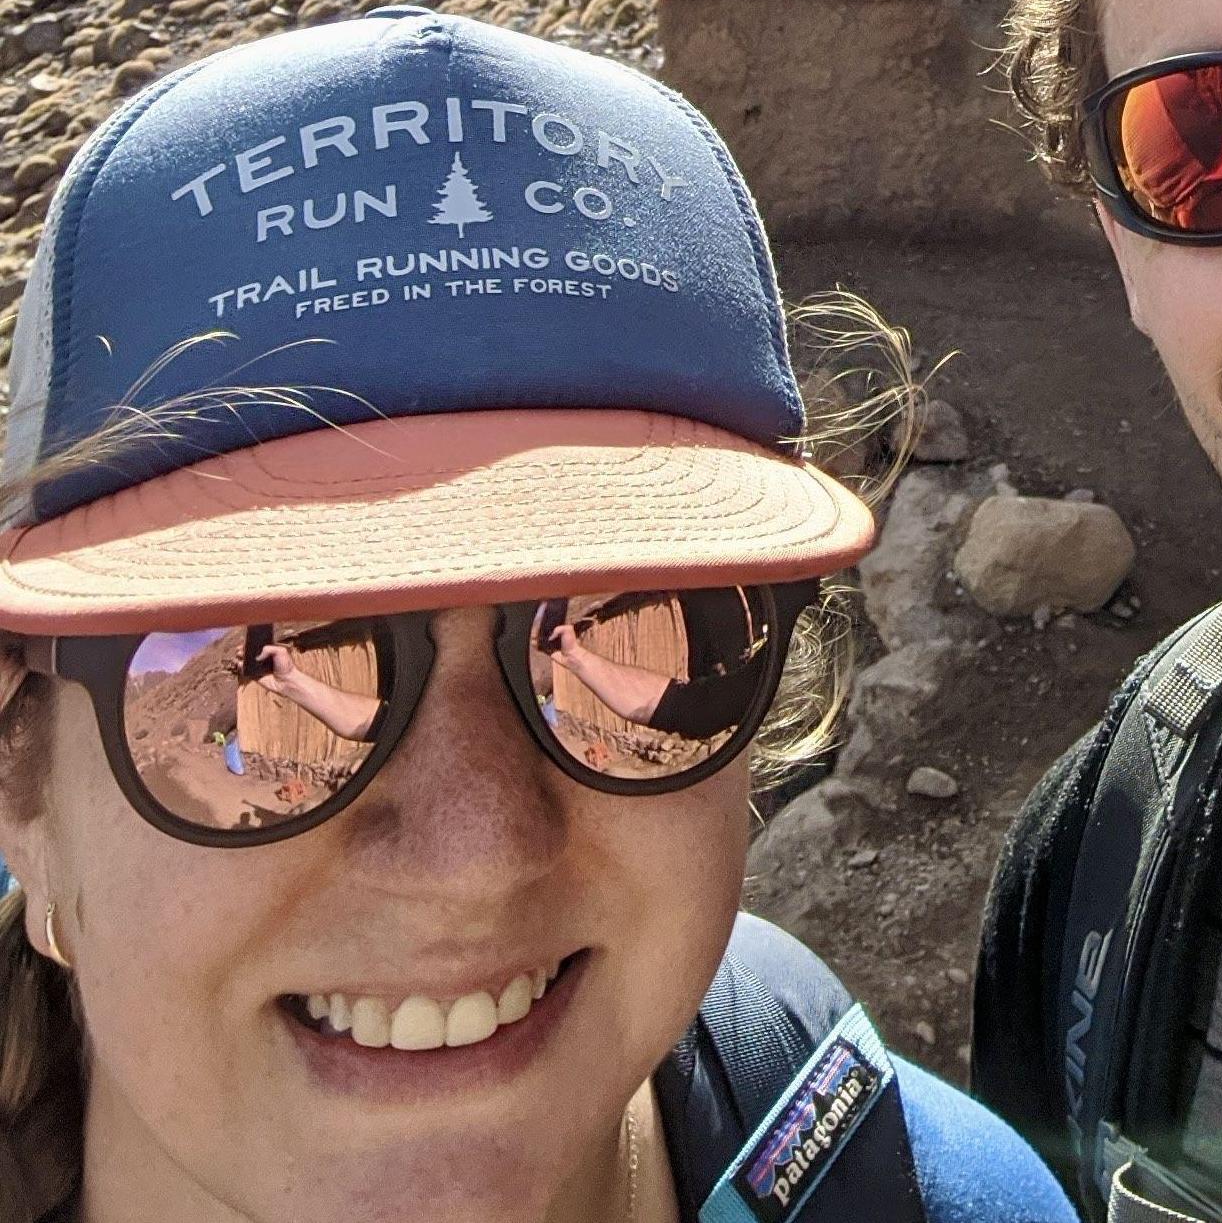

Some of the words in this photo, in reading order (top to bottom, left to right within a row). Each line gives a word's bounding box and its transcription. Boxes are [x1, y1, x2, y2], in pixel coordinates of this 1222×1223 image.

[170, 97, 688, 217] TERRITORY
[256, 184, 398, 243] RUN
[524, 180, 637, 227] CO.
[208, 267, 338, 318] TRAIL
[356, 246, 550, 282] RUNNING
[564, 250, 679, 293] GOODS
[295, 288, 390, 319] FREED
[403, 283, 431, 301] IN
[445, 278, 503, 297] THE
[513, 278, 612, 299] FOREST
[772, 1077, 864, 1208] patagonia
